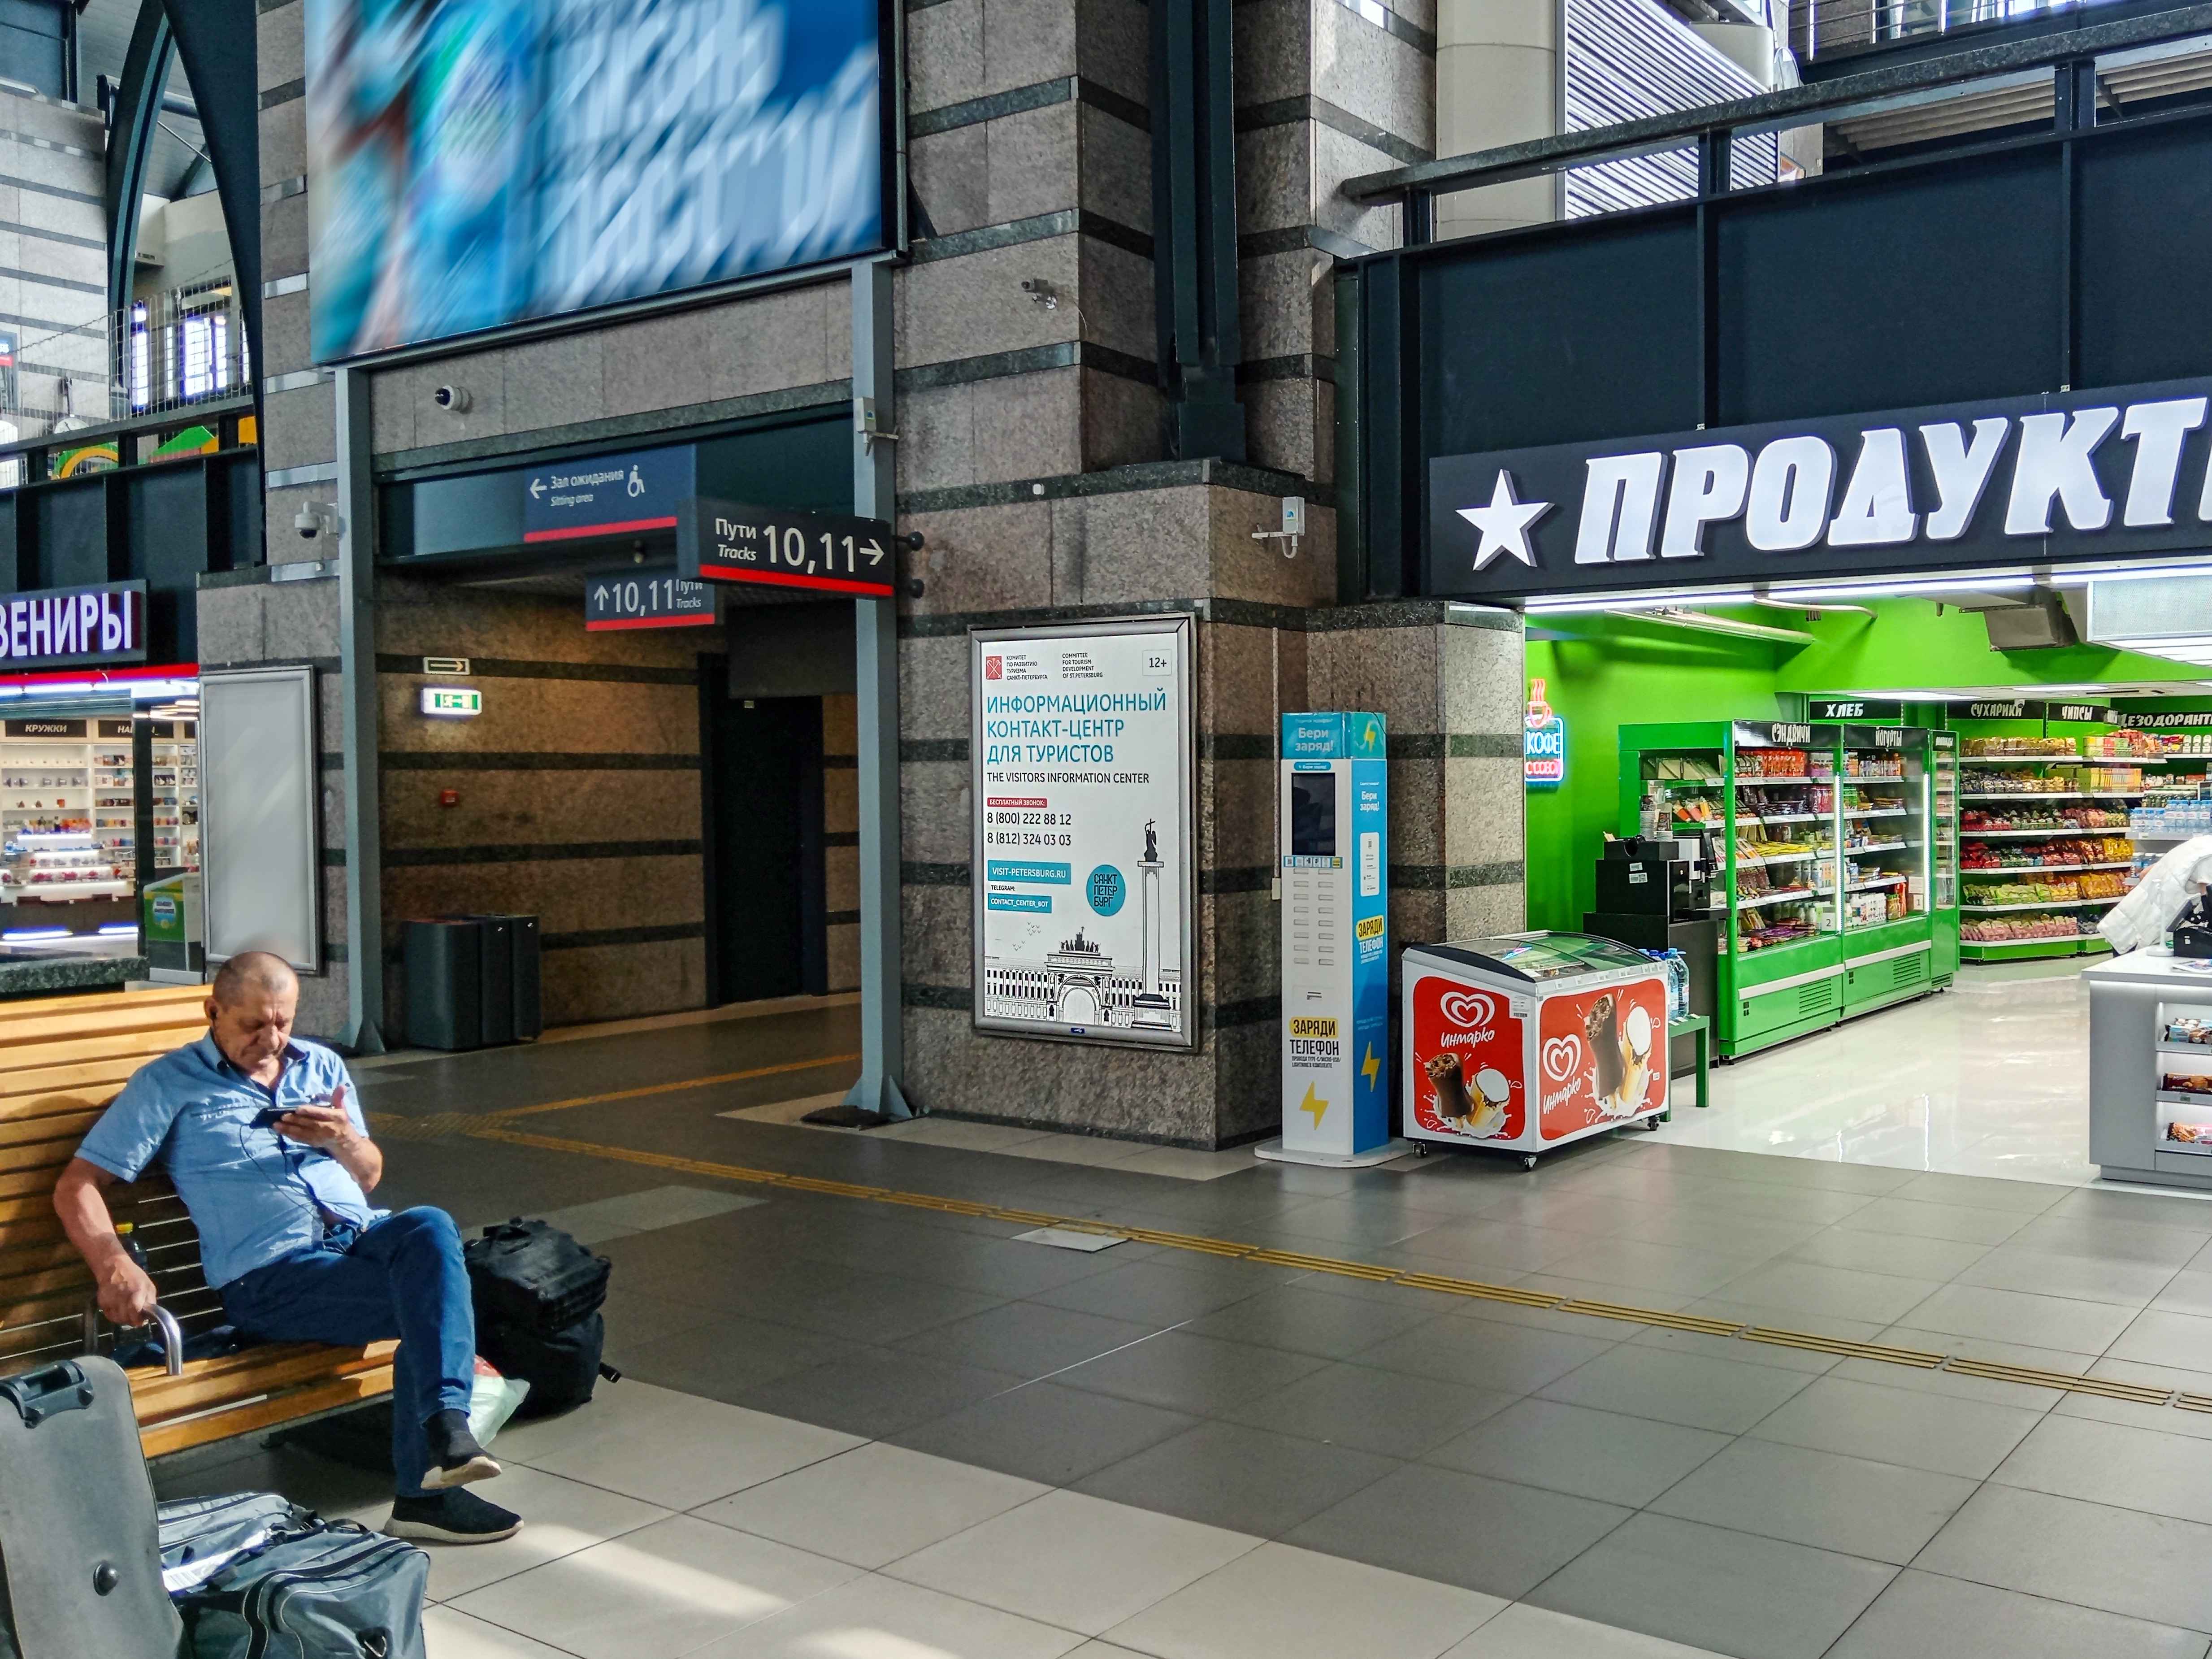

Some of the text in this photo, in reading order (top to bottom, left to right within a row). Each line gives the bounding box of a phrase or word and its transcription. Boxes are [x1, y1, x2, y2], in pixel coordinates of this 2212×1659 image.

[551, 470, 624, 489] Зал ожидания
[1574, 397, 2212, 564] ПРОДУКТ
[551, 495, 575, 507] Sitting
[716, 518, 757, 541] Пути
[718, 544, 757, 561] Tracks
[763, 525, 854, 574] 10,11
[613, 579, 672, 617] 10,11
[676, 597, 702, 608] Tracks
[1149, 657, 1167, 668] 12+
[987, 687, 1166, 714] ИНФОРМАЦИОННЫЙ
[1825, 703, 1864, 717] ХЛЕБ
[1971, 703, 2022, 717] СУХАРИКИ
[2062, 705, 2093, 720] ЧИПСЫ
[2119, 713, 2212, 727] ДЕЗОДОРАНТ
[25, 724, 67, 733] КРУЖКИ
[987, 719, 1124, 740] КОНТАКТ-ЦЕНТР
[1298, 727, 1328, 740] Бери
[1772, 723, 1810, 746] СЭНДВИЧИ
[1525, 731, 1560, 754] КОФЕ
[1875, 726, 1902, 747] ЙОГУРТЫ
[1295, 740, 1334, 753] заряд!
[987, 745, 1114, 764] ДЛЯ ТУРИСТОВ
[987, 772, 1149, 783] THE VISITORS INFORMATION CENTER
[1362, 791, 1377, 802] Бери
[1360, 801, 1379, 812] заряд!
[987, 812, 1071, 825] 8 (800) 222 88 12
[987, 832, 1071, 846] 8 (812) 324 03 03
[992, 867, 1066, 878] VISIT-PETERSBURG.RU
[1094, 873, 1117, 884] САНКТ
[1094, 885, 1118, 896] ПЕТЕР
[990, 898, 1049, 908] CONTACT_CENTER_BOT
[1094, 896, 1114, 908] БУРГ
[1358, 918, 1382, 938] ЗАРЯДИ
[1359, 936, 1383, 954] ТЕЛЕФОН
[1293, 1019, 1336, 1037] ЗАРЯДИ
[1289, 1039, 1339, 1055] ТЕЛЕФОН
